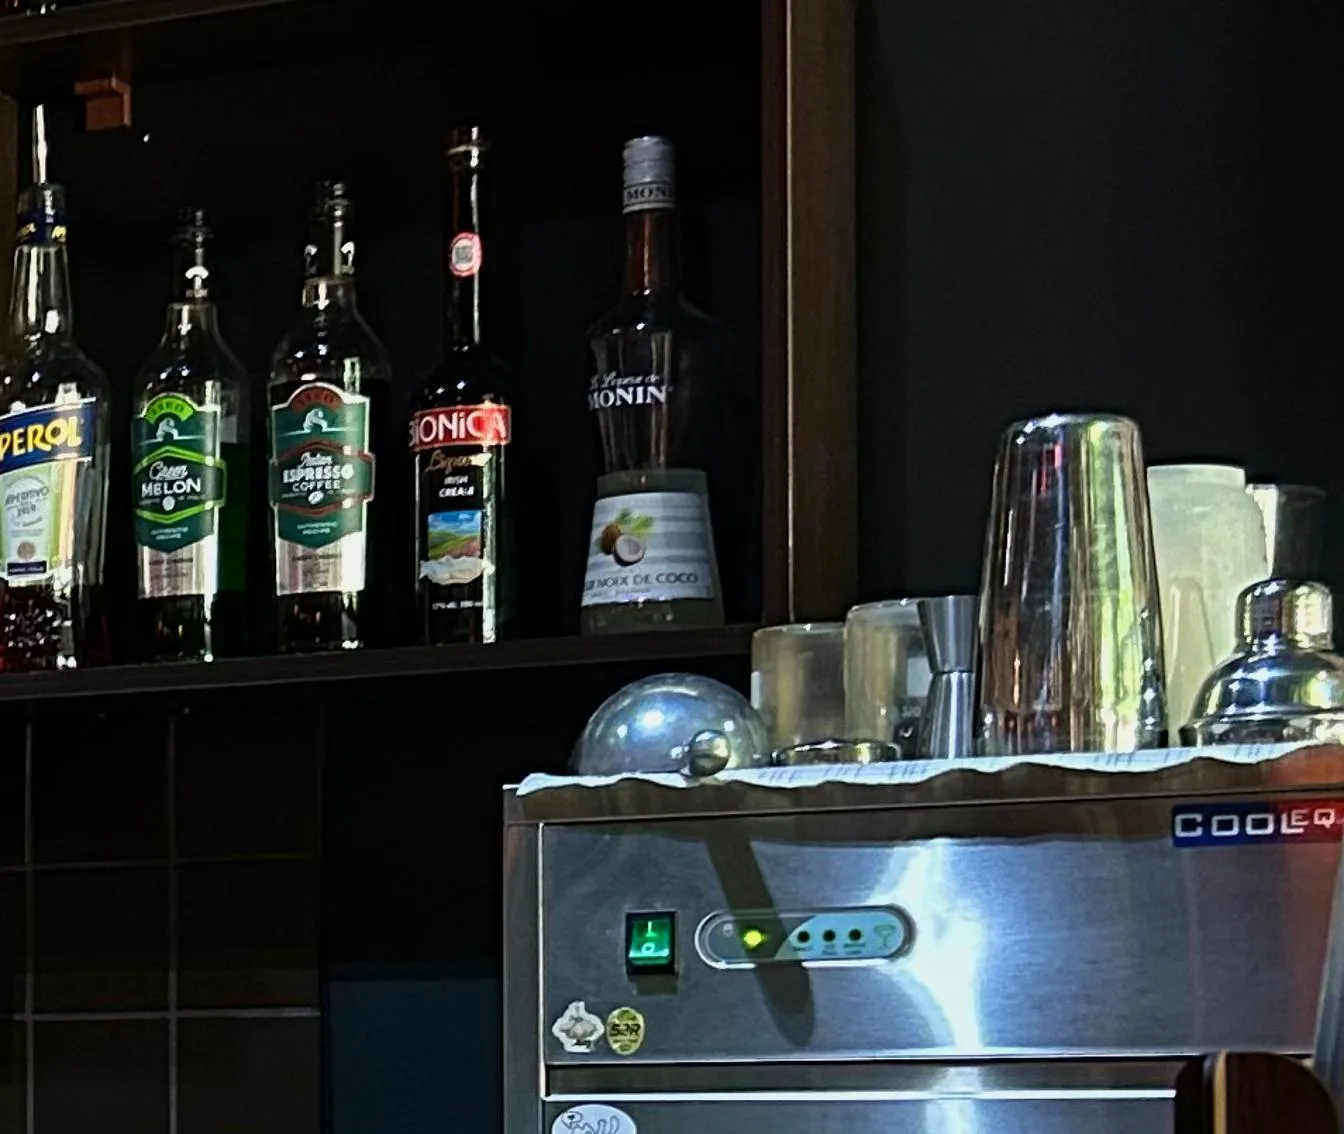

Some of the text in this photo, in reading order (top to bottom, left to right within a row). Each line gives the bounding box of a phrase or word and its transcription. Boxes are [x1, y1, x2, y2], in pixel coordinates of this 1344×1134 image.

[141, 478, 202, 498] MELON
[292, 480, 341, 493] COFFEE
[655, 572, 699, 584] COCO
[1174, 808, 1336, 838] COOLEQ
